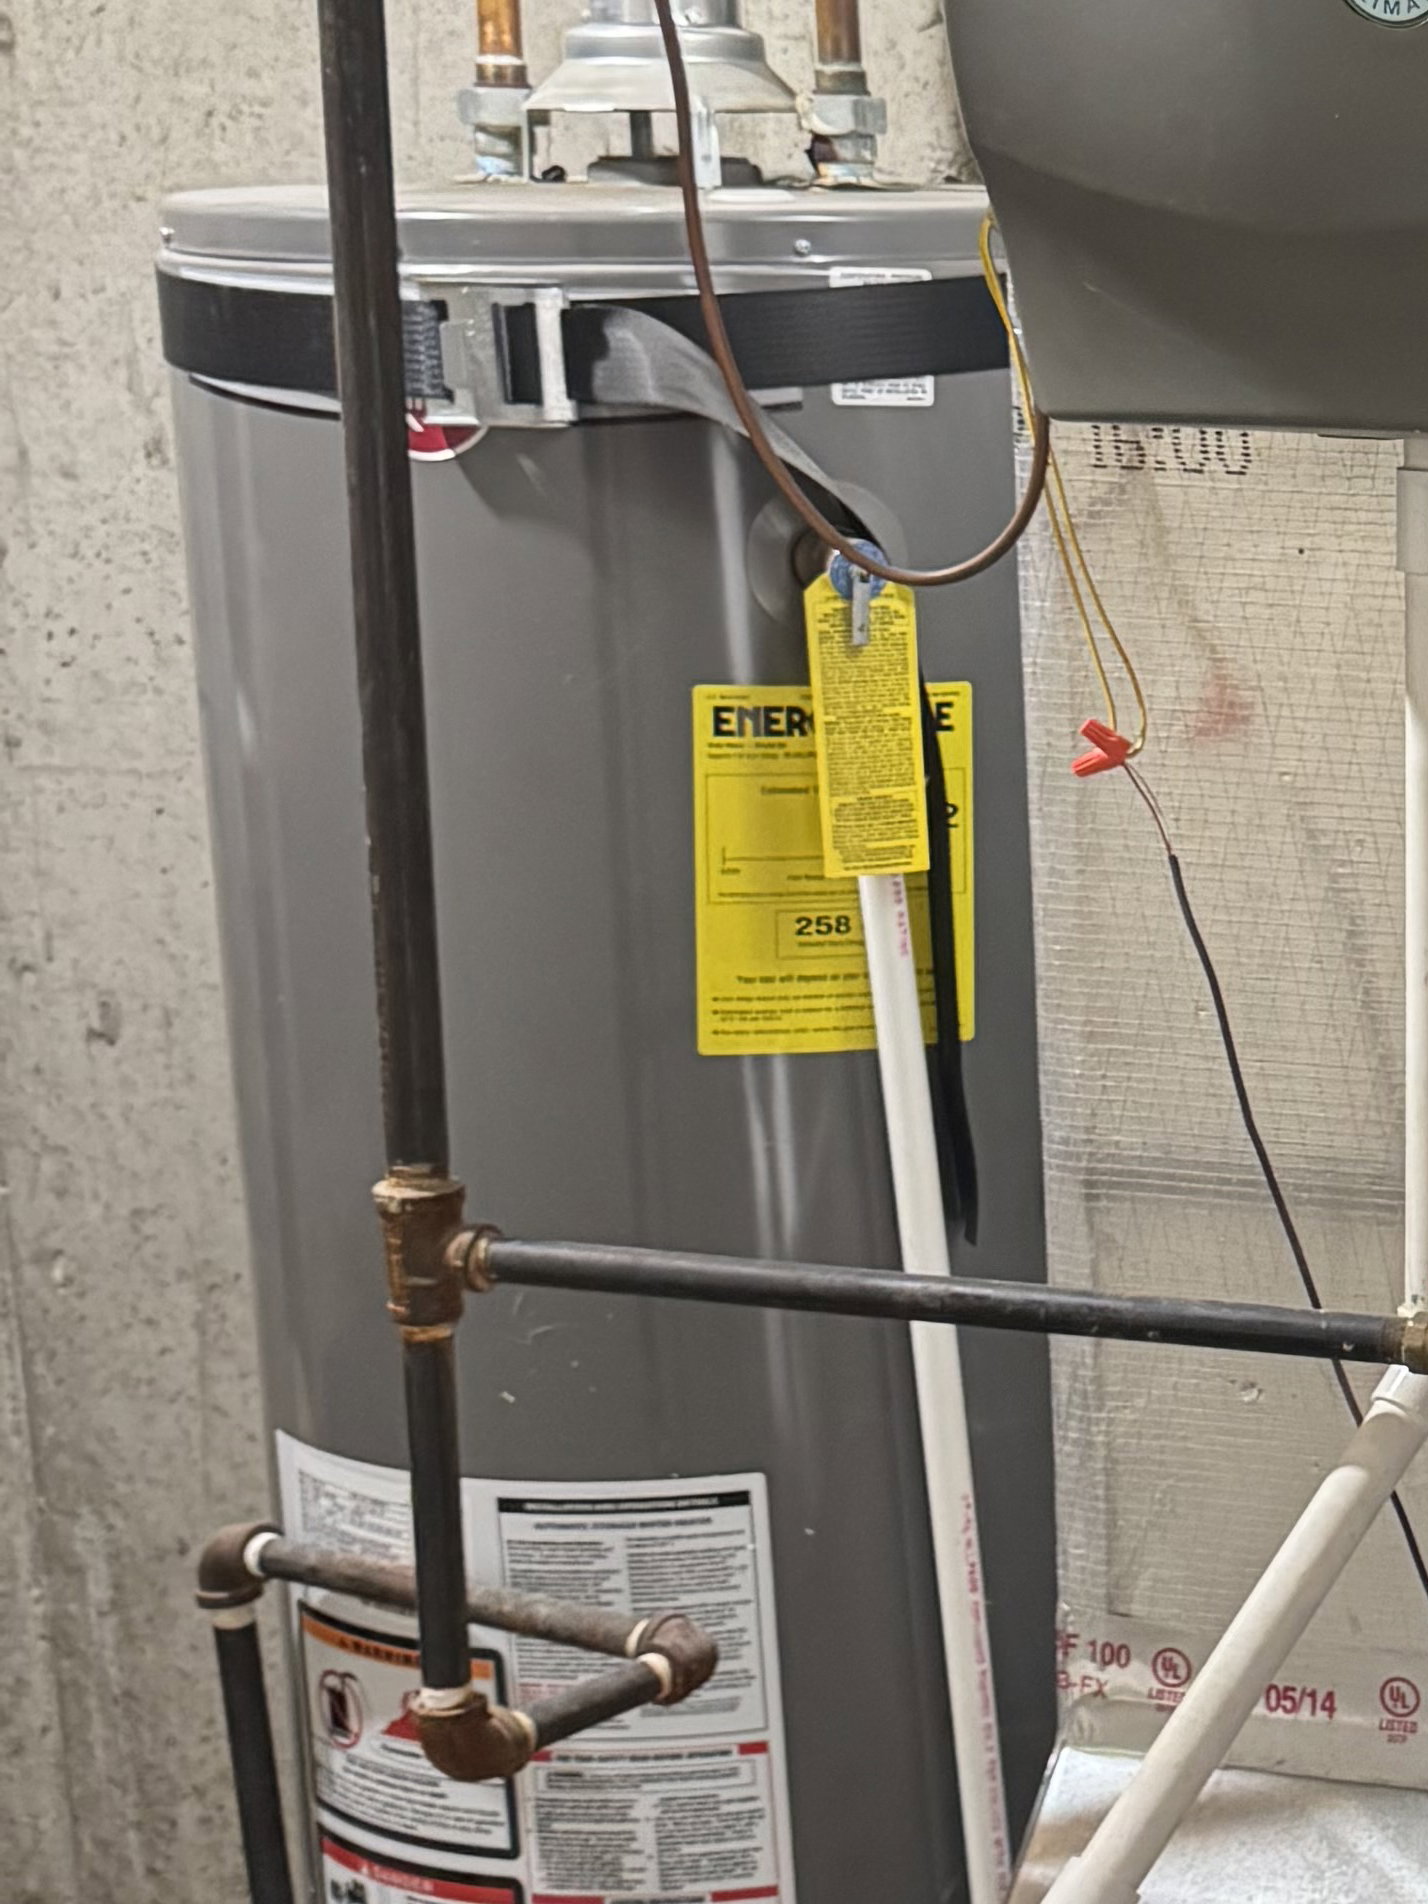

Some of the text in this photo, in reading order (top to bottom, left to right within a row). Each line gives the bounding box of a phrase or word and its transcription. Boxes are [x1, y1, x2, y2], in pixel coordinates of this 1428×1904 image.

[713, 705, 814, 738] ENER
[795, 915, 851, 937] 258
[1087, 1640, 1131, 1668] 100
[1148, 1687, 1186, 1703] LISTE
[1265, 1683, 1337, 1720] 05/14
[1379, 1717, 1418, 1734] LISTED
